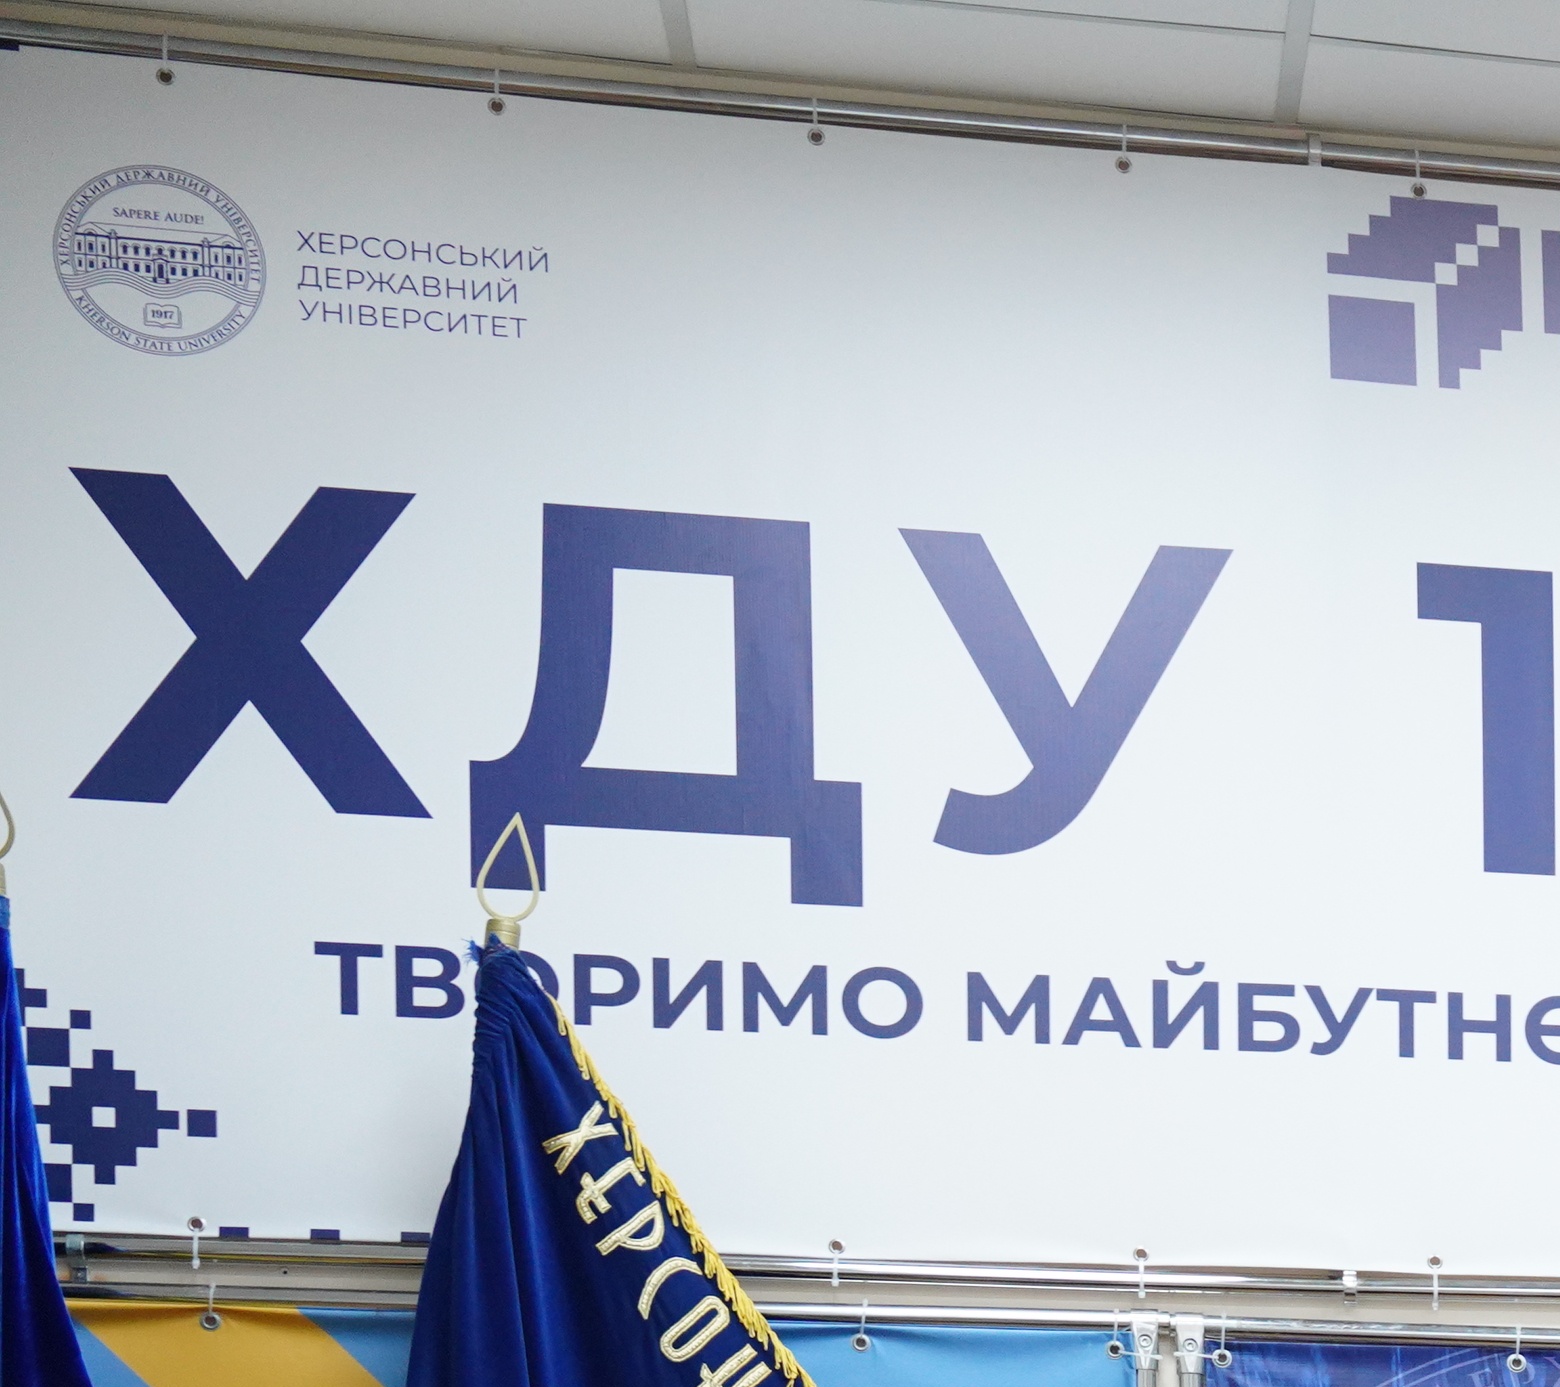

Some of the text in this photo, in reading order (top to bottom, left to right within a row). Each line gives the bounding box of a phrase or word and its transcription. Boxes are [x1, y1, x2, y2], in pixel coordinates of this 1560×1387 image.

[112, 206, 205, 225] SAPERE AUDE!
[114, 168, 211, 197] ДЕРЖАВНИЙ
[213, 193, 261, 285] УНІВЕРСИТЕТ
[296, 230, 550, 274] ХЕРСОНСЬКИЙ
[297, 265, 518, 304] ДЕРЖАВНИЙ
[75, 294, 250, 354] KHERSON STATE UNIVERSITY
[150, 308, 175, 321] 1917
[298, 299, 528, 340] УНІВЕРСИТЕТ
[68, 466, 1233, 908] ХДУ
